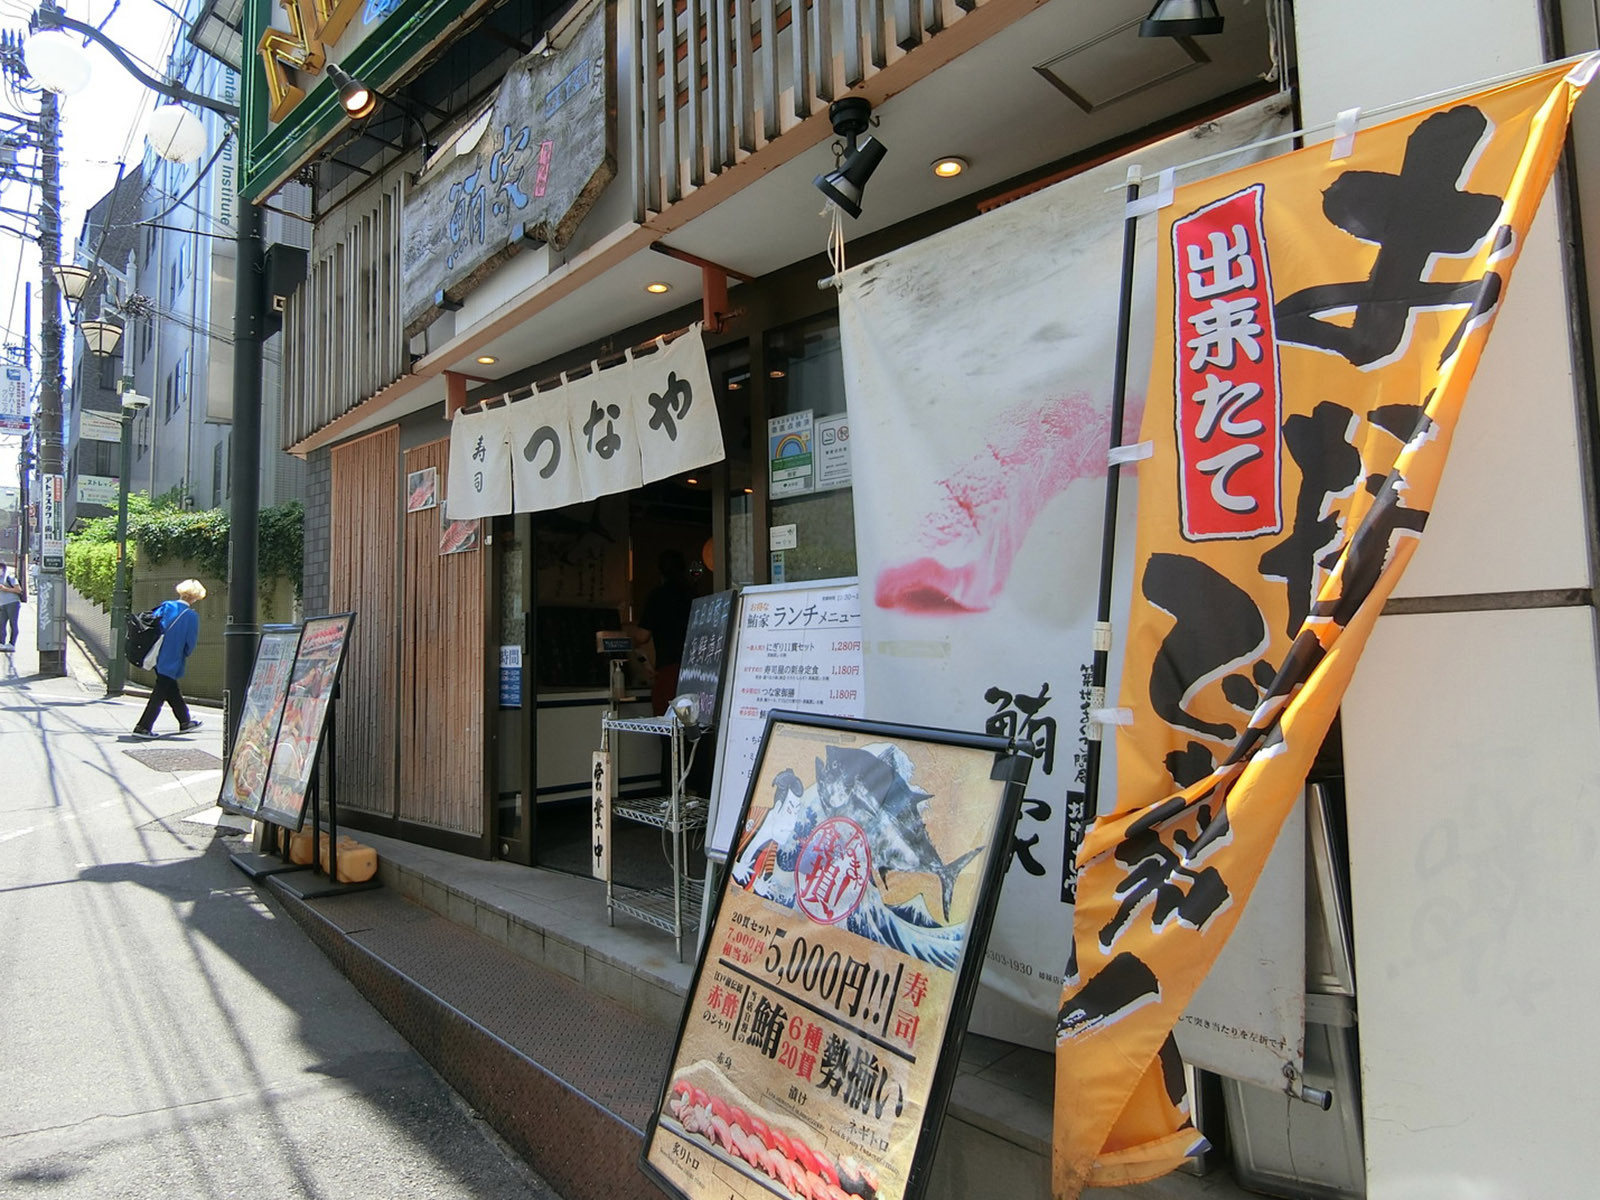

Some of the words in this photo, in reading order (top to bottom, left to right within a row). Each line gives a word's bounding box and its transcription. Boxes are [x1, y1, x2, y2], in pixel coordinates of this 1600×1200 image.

[220, 165, 234, 226] Institute
[1187, 223, 1262, 514] 出来たて
[523, 371, 693, 480] つなや
[472, 435, 487, 494] 寿司
[747, 614, 769, 628] 鮪家
[774, 604, 861, 627] ランチメニュー
[832, 641, 861, 651] 1,280円
[764, 665, 819, 675] 寿司屋の刺身定食
[831, 665, 860, 675] 1,180円
[829, 689, 858, 700] 1,180円
[593, 761, 605, 869] 営業中
[726, 927, 766, 954] 7,000円
[731, 912, 772, 939] 20貫セット
[722, 943, 752, 964] 相当が
[765, 928, 890, 1025] 5,000円!!
[707, 986, 740, 1019] 赤酢
[894, 971, 929, 1049] 寿司
[702, 1009, 731, 1034] のシャリ
[746, 996, 788, 1058] 鮪
[788, 1016, 823, 1054] 6種
[716, 1052, 732, 1070] 赤身
[778, 1043, 816, 1082] 20貫
[817, 1033, 904, 1119] 勢揃い
[788, 1085, 807, 1105] 漬け
[848, 1119, 890, 1153] ネギトロ
[672, 1142, 700, 1170] 炙りトロ
